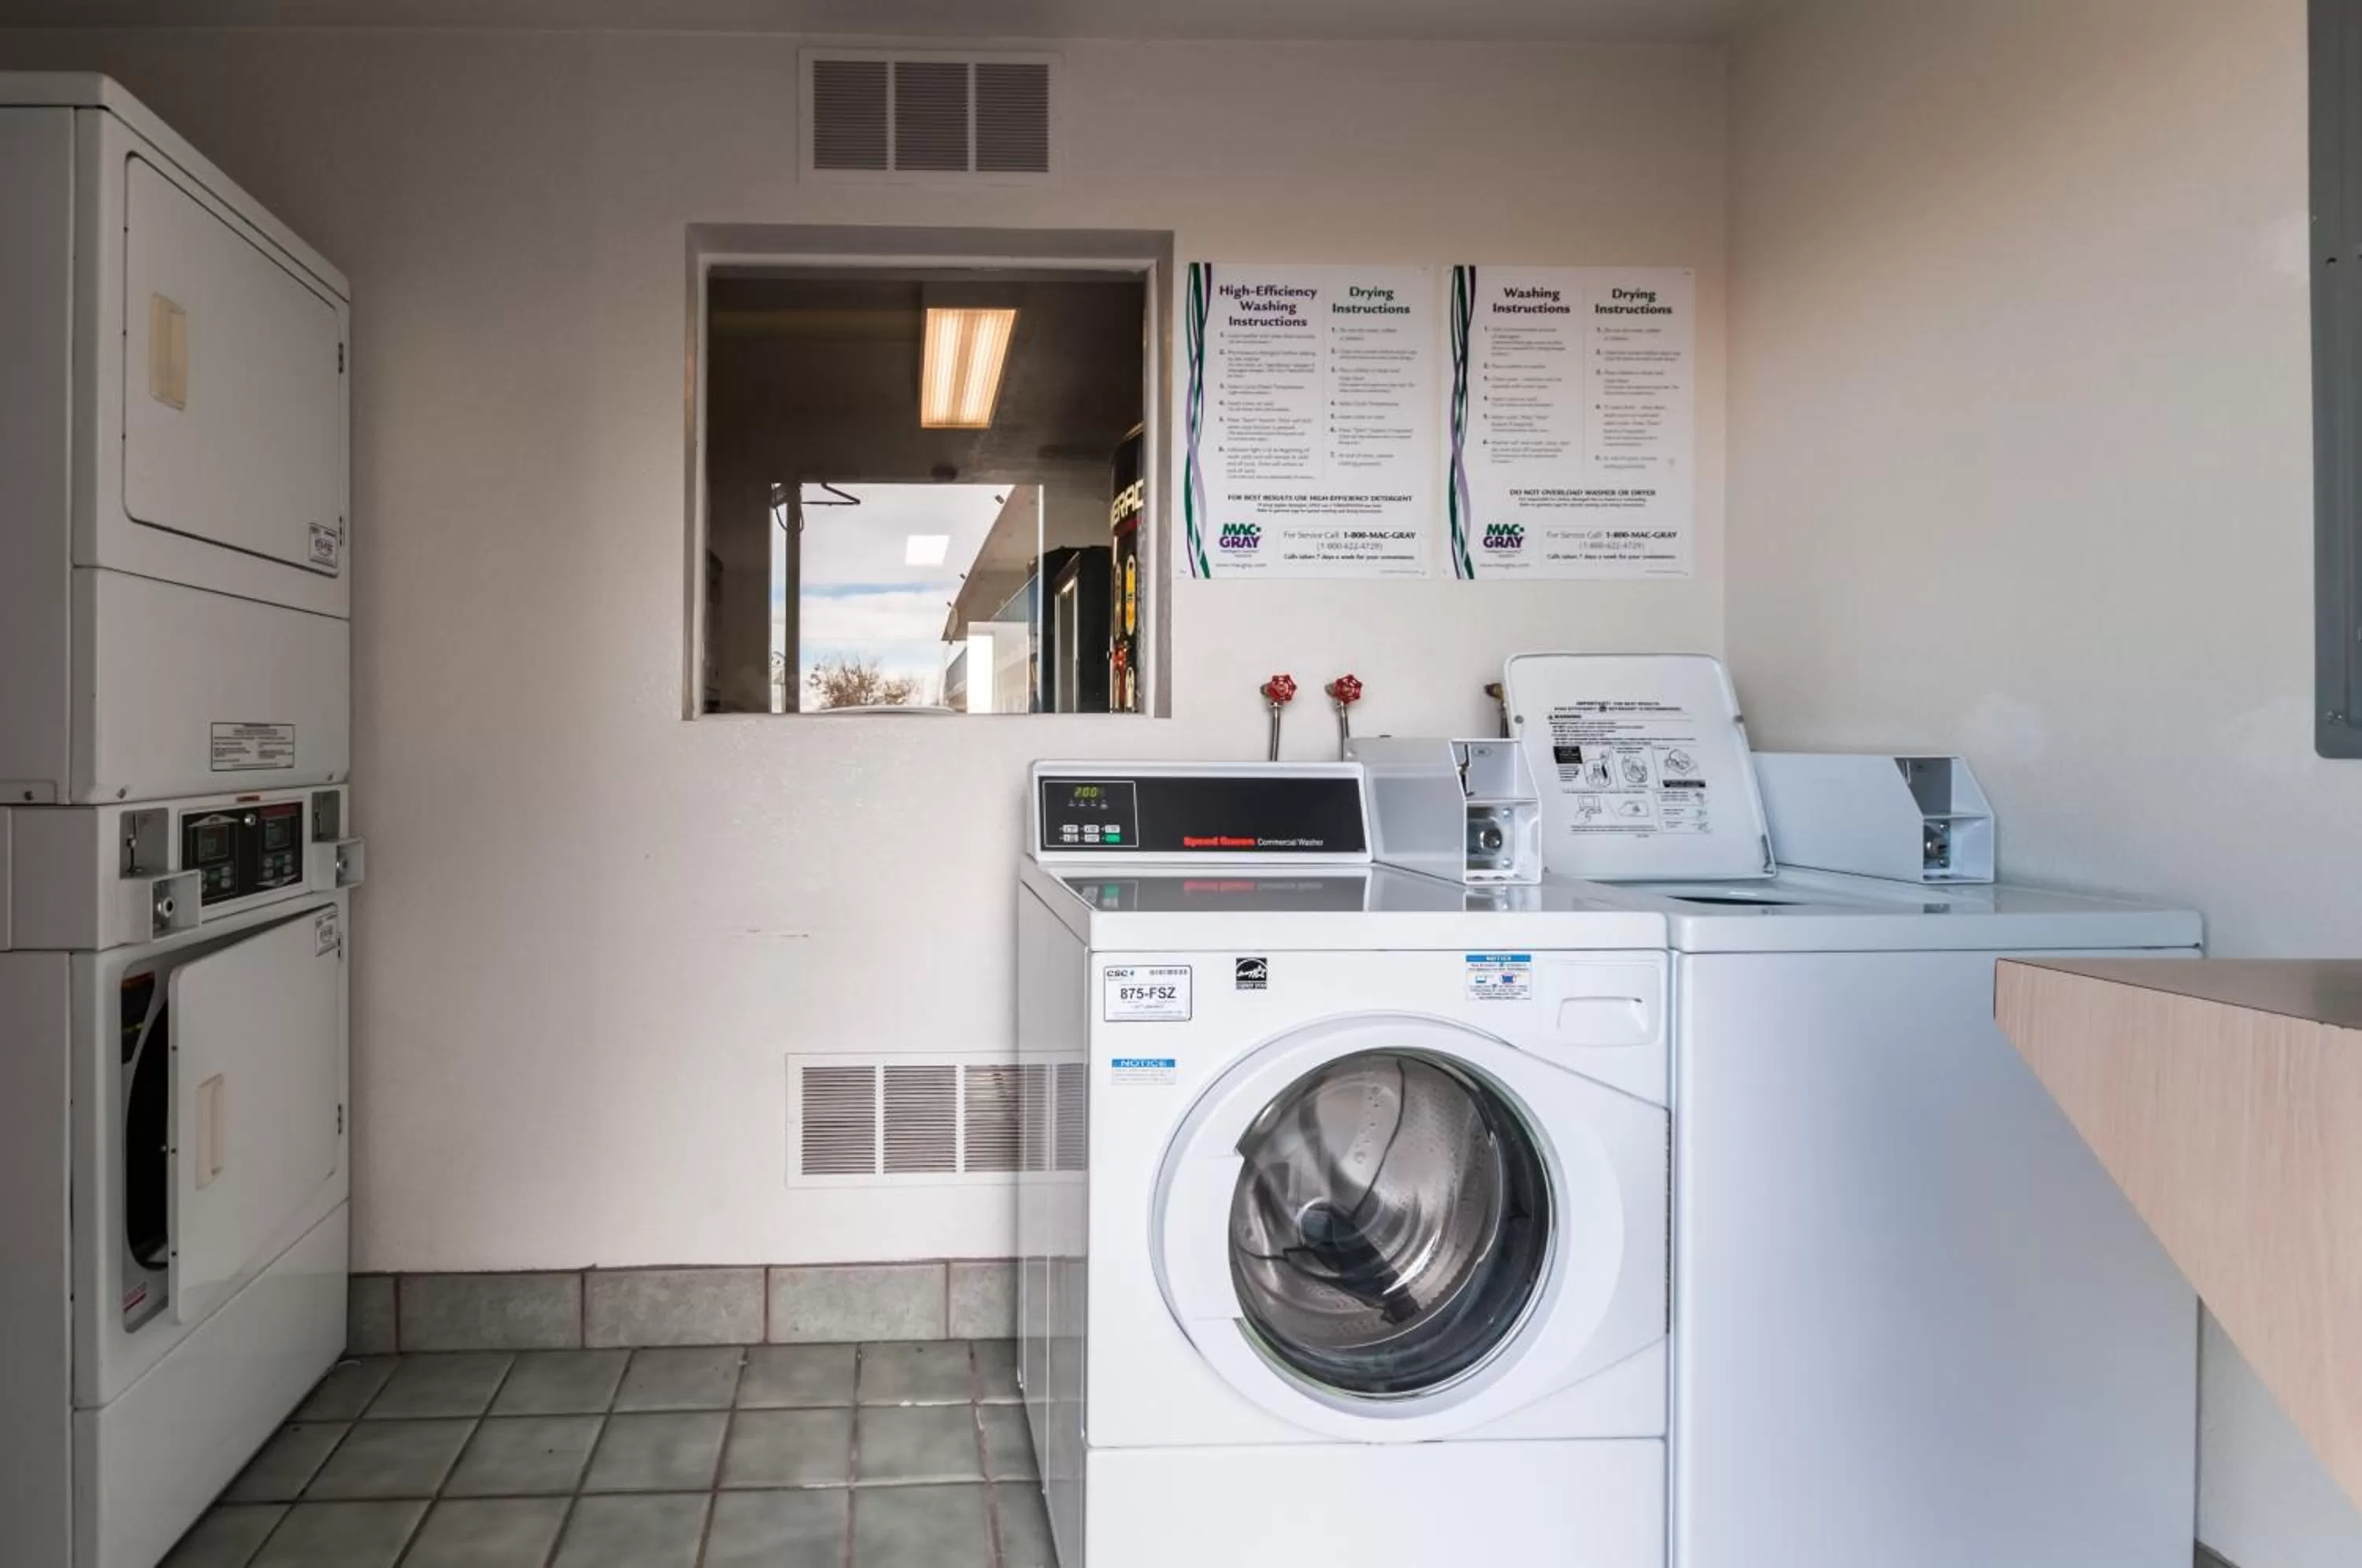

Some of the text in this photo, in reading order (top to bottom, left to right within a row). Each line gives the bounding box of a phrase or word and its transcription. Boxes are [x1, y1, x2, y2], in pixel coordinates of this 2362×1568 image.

[1219, 284, 1317, 300] High-Efficiency
[1349, 285, 1394, 301] Drying
[1504, 287, 1560, 302] Washing
[1612, 287, 1657, 303] Drying
[1240, 300, 1298, 315] Washing
[1332, 302, 1411, 314] Instructions
[1493, 302, 1571, 314] Instructions
[1594, 303, 1673, 314] Instructions
[1229, 315, 1309, 327] Instructions
[1219, 536, 1261, 548] GRAY
[1483, 536, 1523, 548] GRAY
[1120, 986, 1178, 1000] 875-FSZ
[1120, 1059, 1167, 1067] NOTICE
